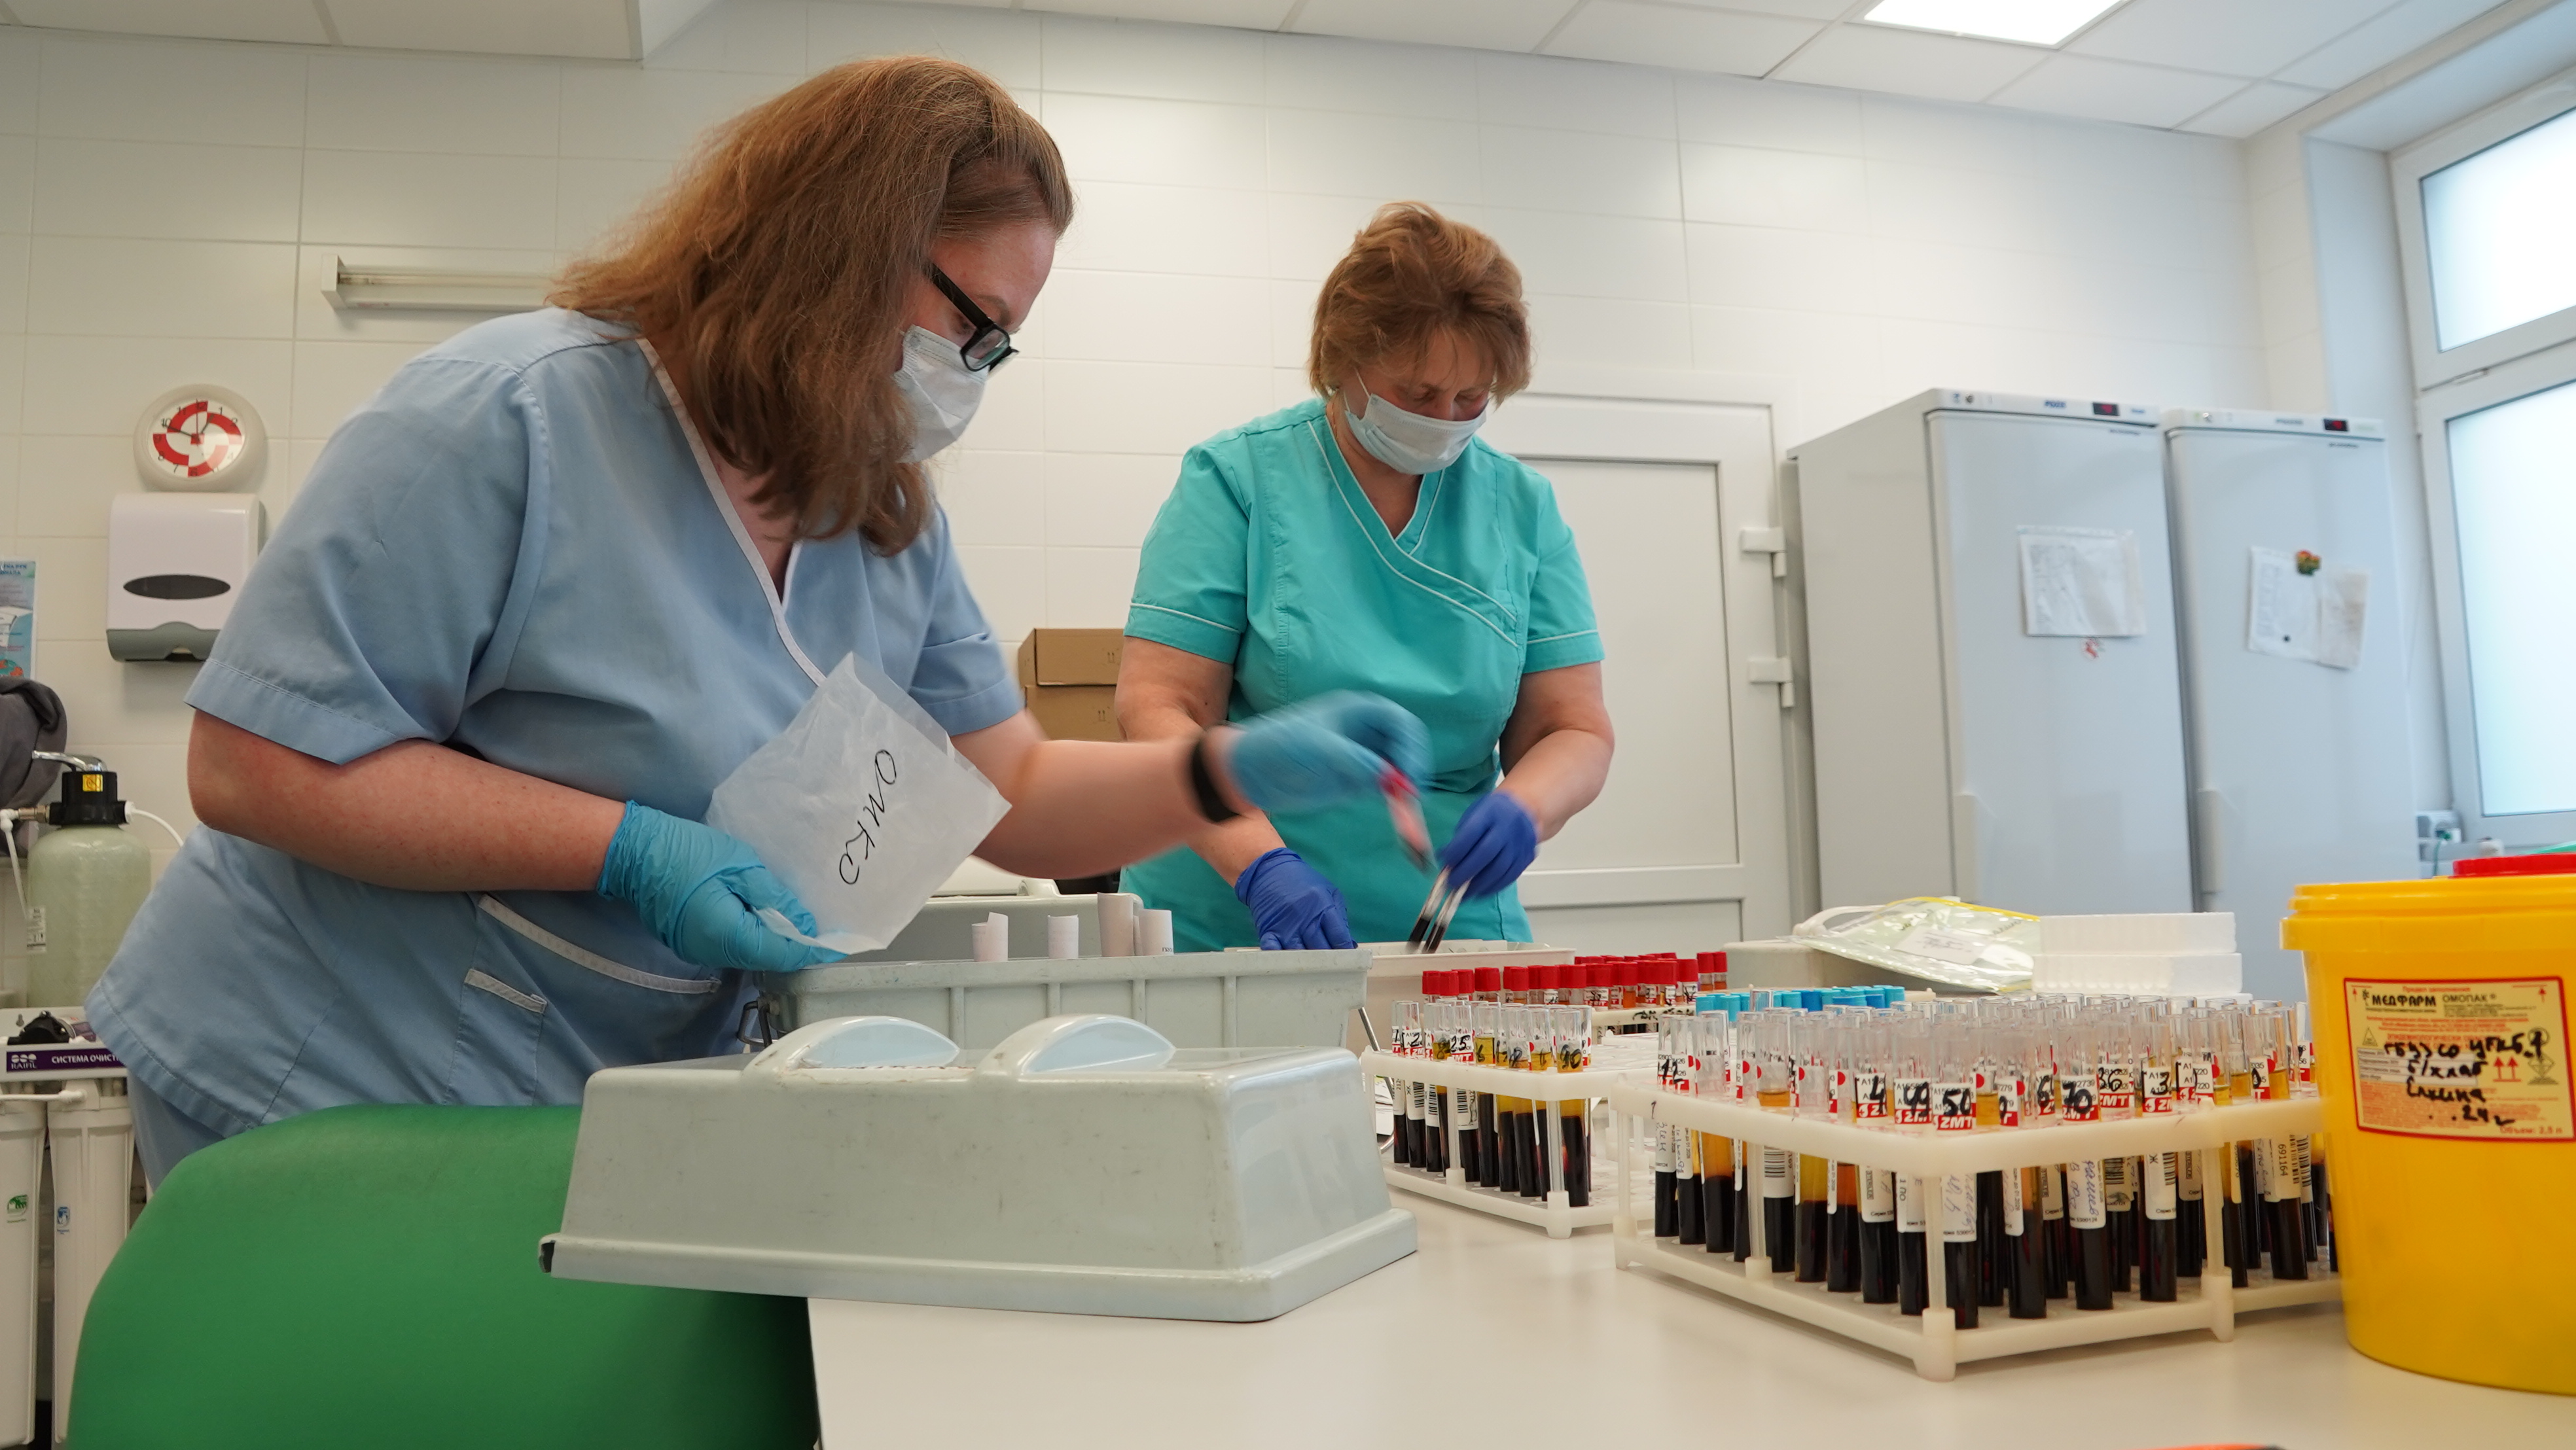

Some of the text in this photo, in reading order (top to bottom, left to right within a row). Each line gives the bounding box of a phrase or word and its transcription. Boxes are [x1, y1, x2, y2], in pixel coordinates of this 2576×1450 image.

[2372, 994, 2437, 1007] МЕДФАРМ
[2442, 993, 2488, 1003] ОМОПАК
[51, 1054, 89, 1064] СИСТЕМА
[1903, 1082, 1930, 1118] 49
[1942, 1088, 1972, 1116] 50
[2062, 1082, 2093, 1114] 70
[1941, 1116, 1973, 1129] ZMT
[2278, 1143, 2288, 1176] 691164
